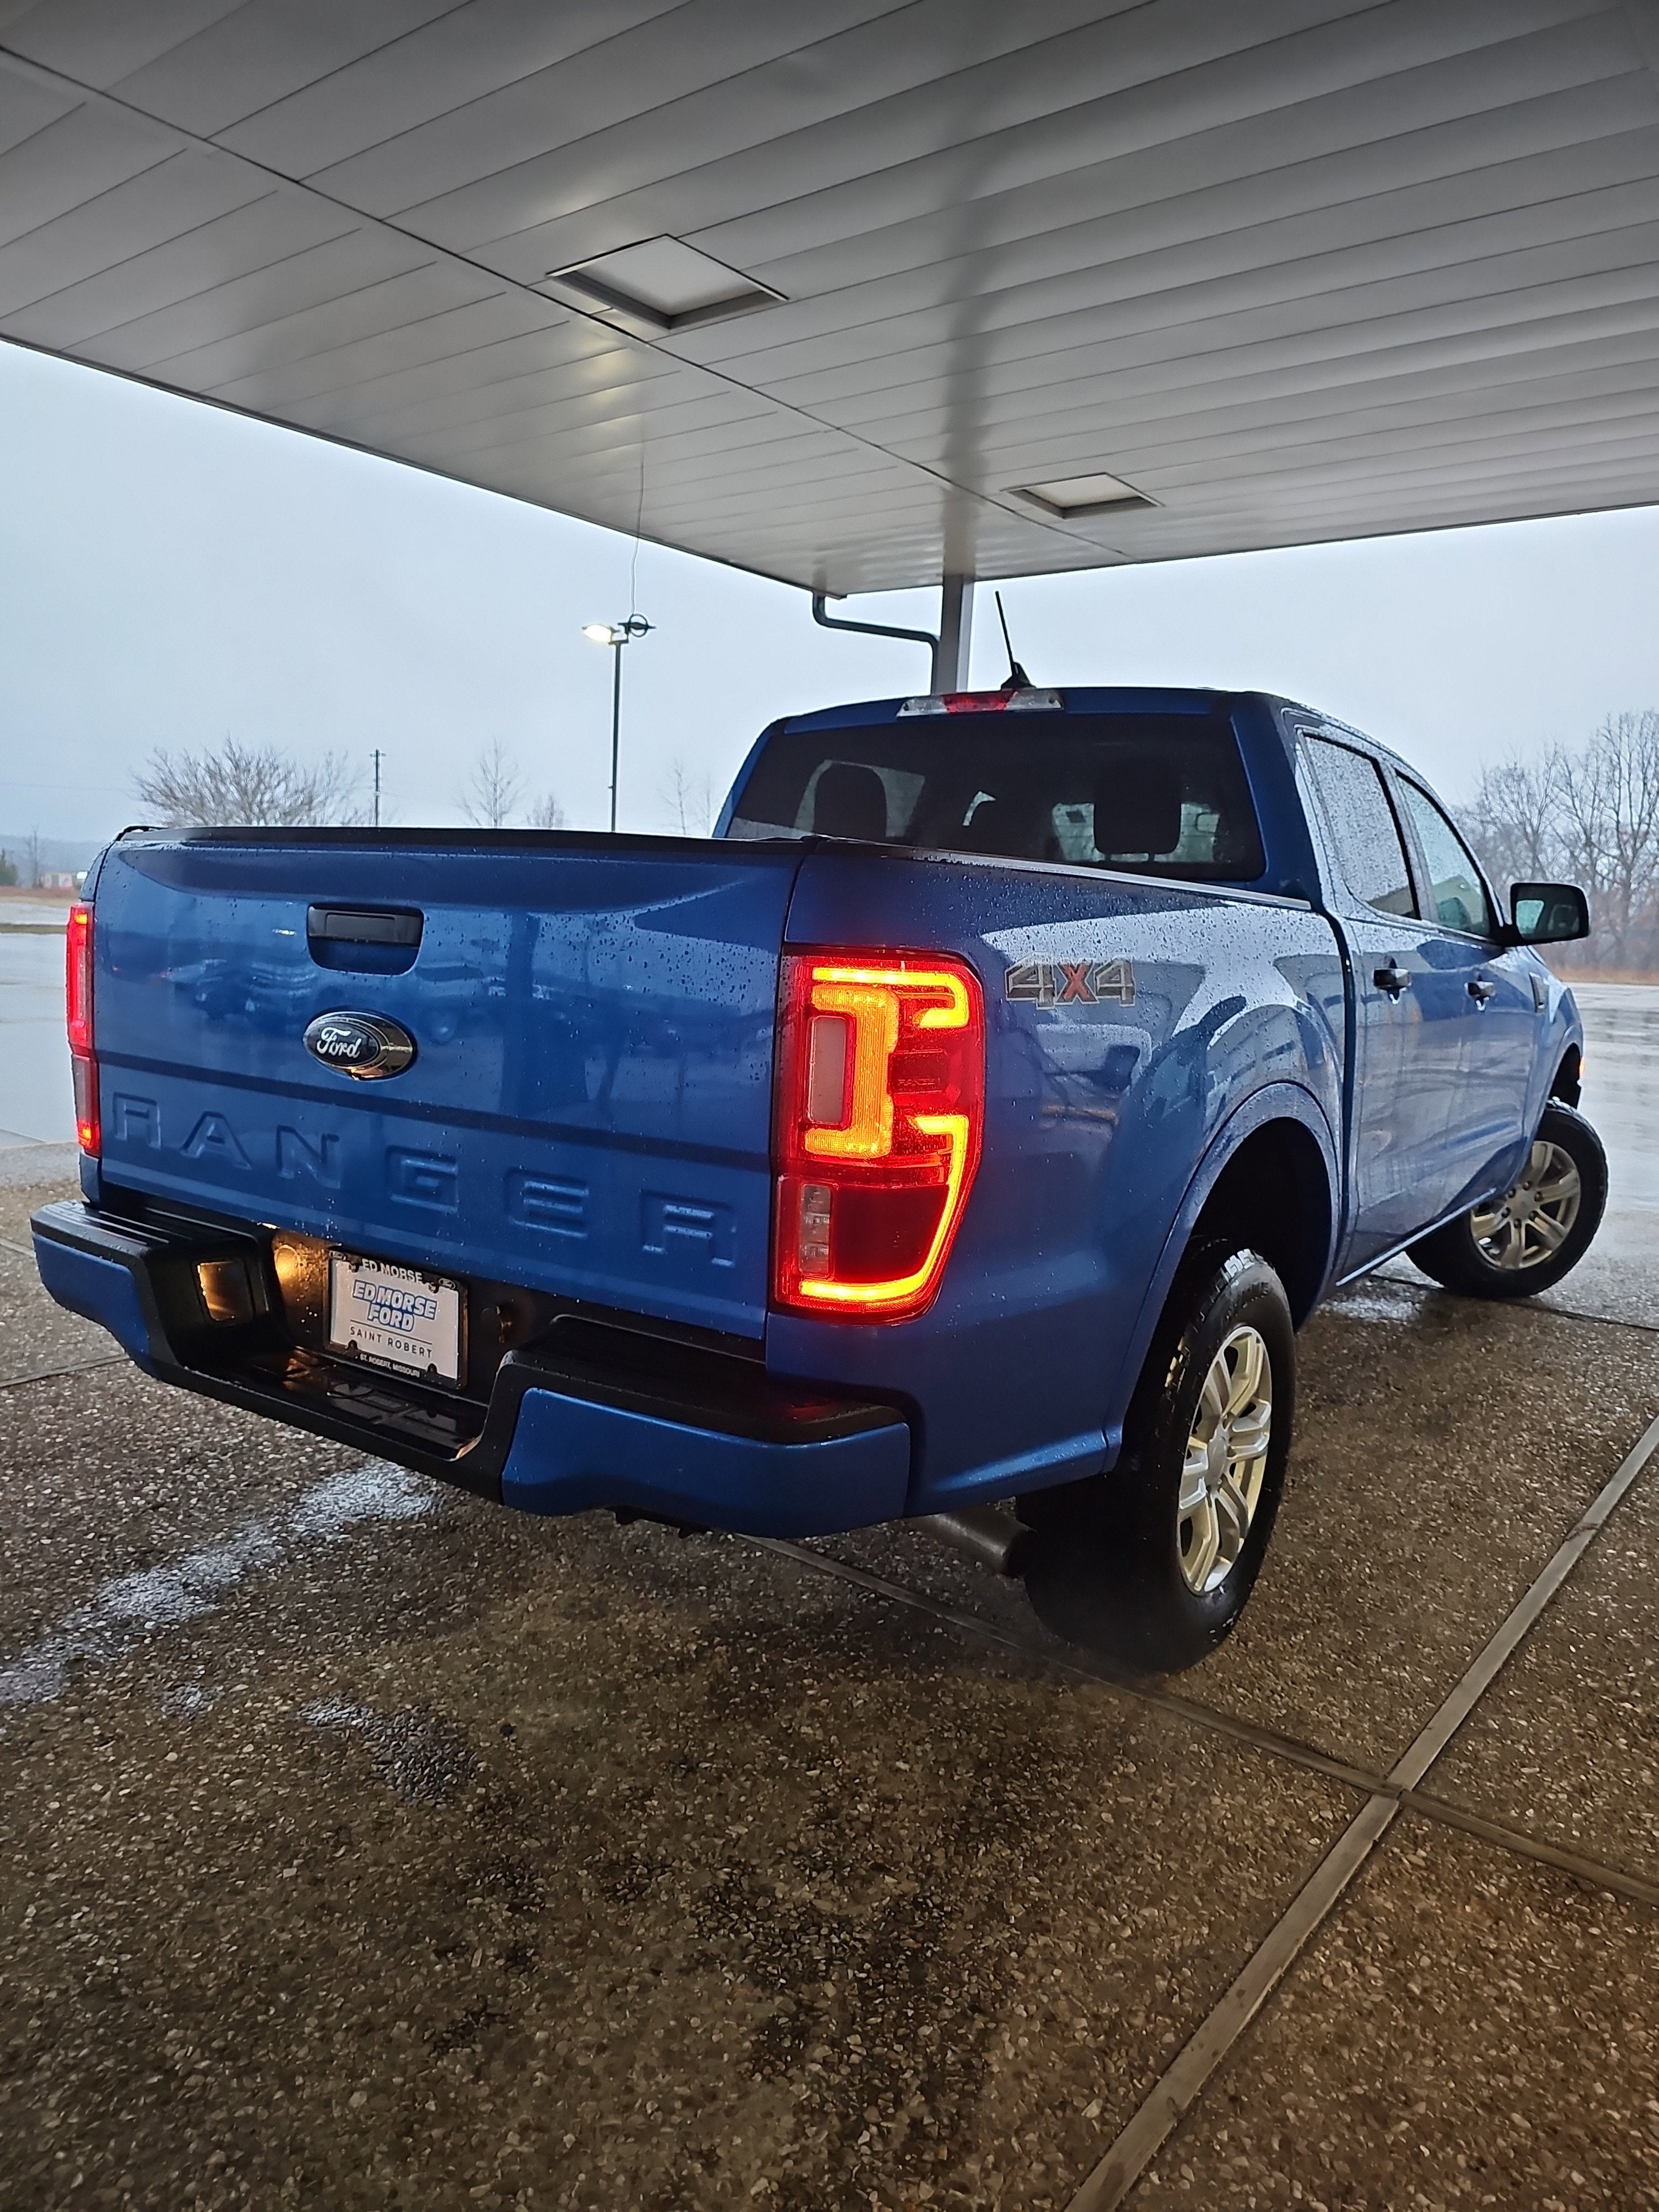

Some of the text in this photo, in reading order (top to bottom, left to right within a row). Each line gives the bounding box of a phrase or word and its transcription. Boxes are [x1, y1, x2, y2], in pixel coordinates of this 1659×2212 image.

[317, 1027, 362, 1058] Ford
[112, 1091, 736, 1267] RANGER
[362, 1258, 423, 1283] ED MORSE
[353, 1279, 438, 1321] ED MORSE
[367, 1302, 415, 1332] FORD
[350, 1326, 433, 1359] SAINT ROBERT
